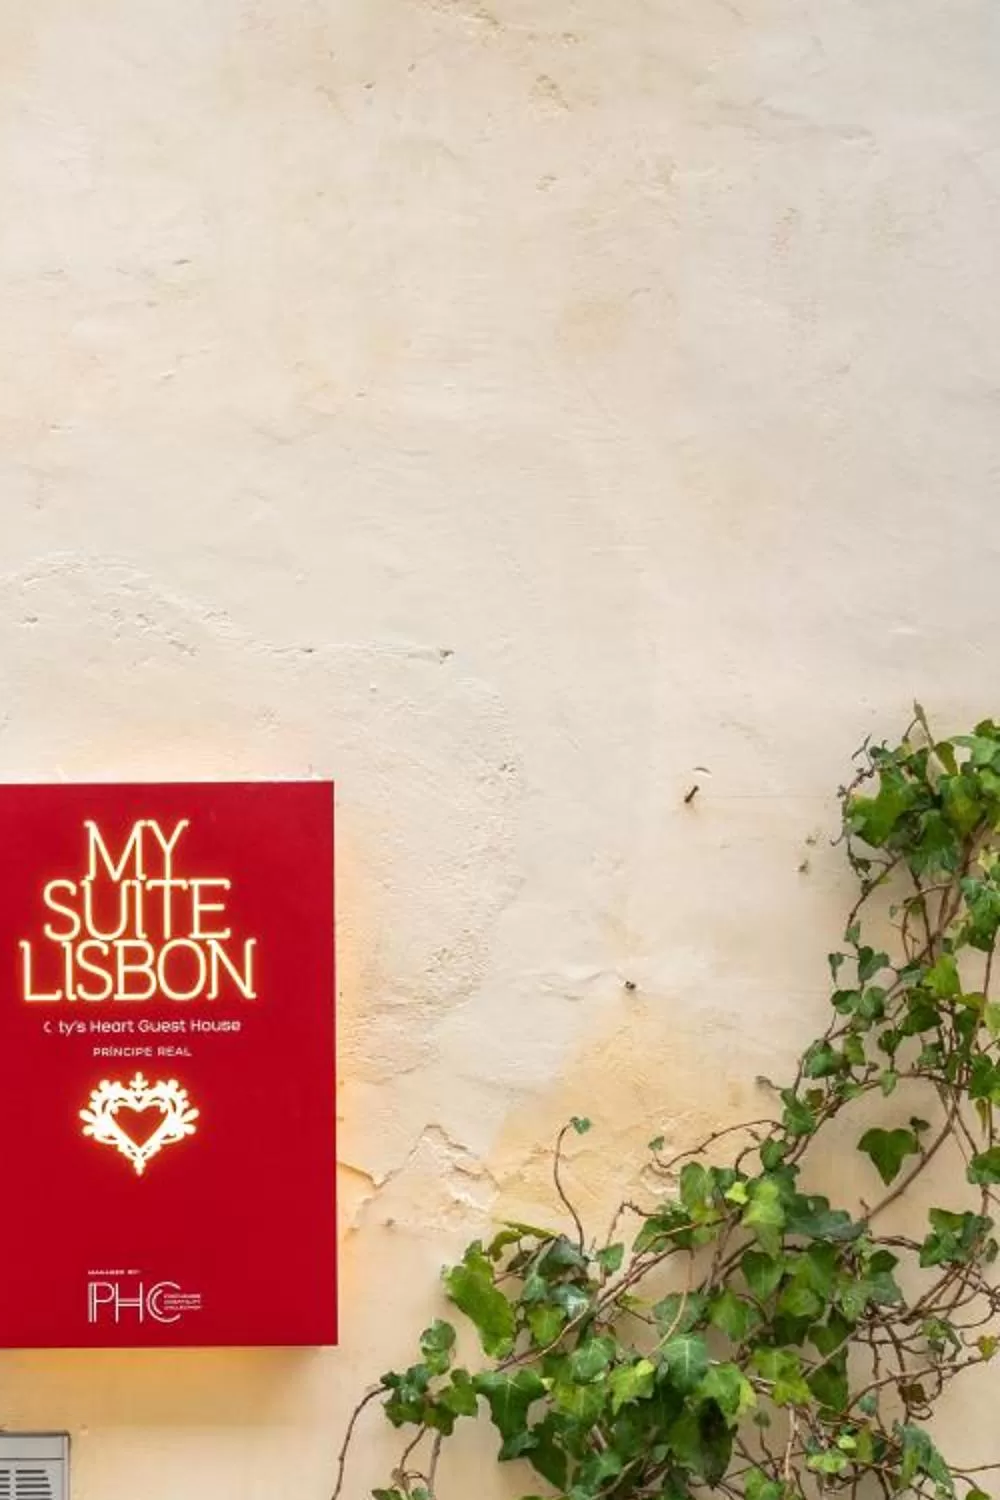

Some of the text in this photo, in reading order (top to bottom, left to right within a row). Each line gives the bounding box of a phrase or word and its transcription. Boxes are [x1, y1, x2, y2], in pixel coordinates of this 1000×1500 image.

[84, 820, 189, 881] MY
[43, 879, 231, 941] SUITE
[19, 938, 257, 1001] LISBON
[90, 1020, 134, 1033] Heart
[138, 1019, 186, 1033] Guest
[190, 1019, 241, 1032] House
[157, 1046, 192, 1057] REAL
[88, 1281, 181, 1323] PHC
